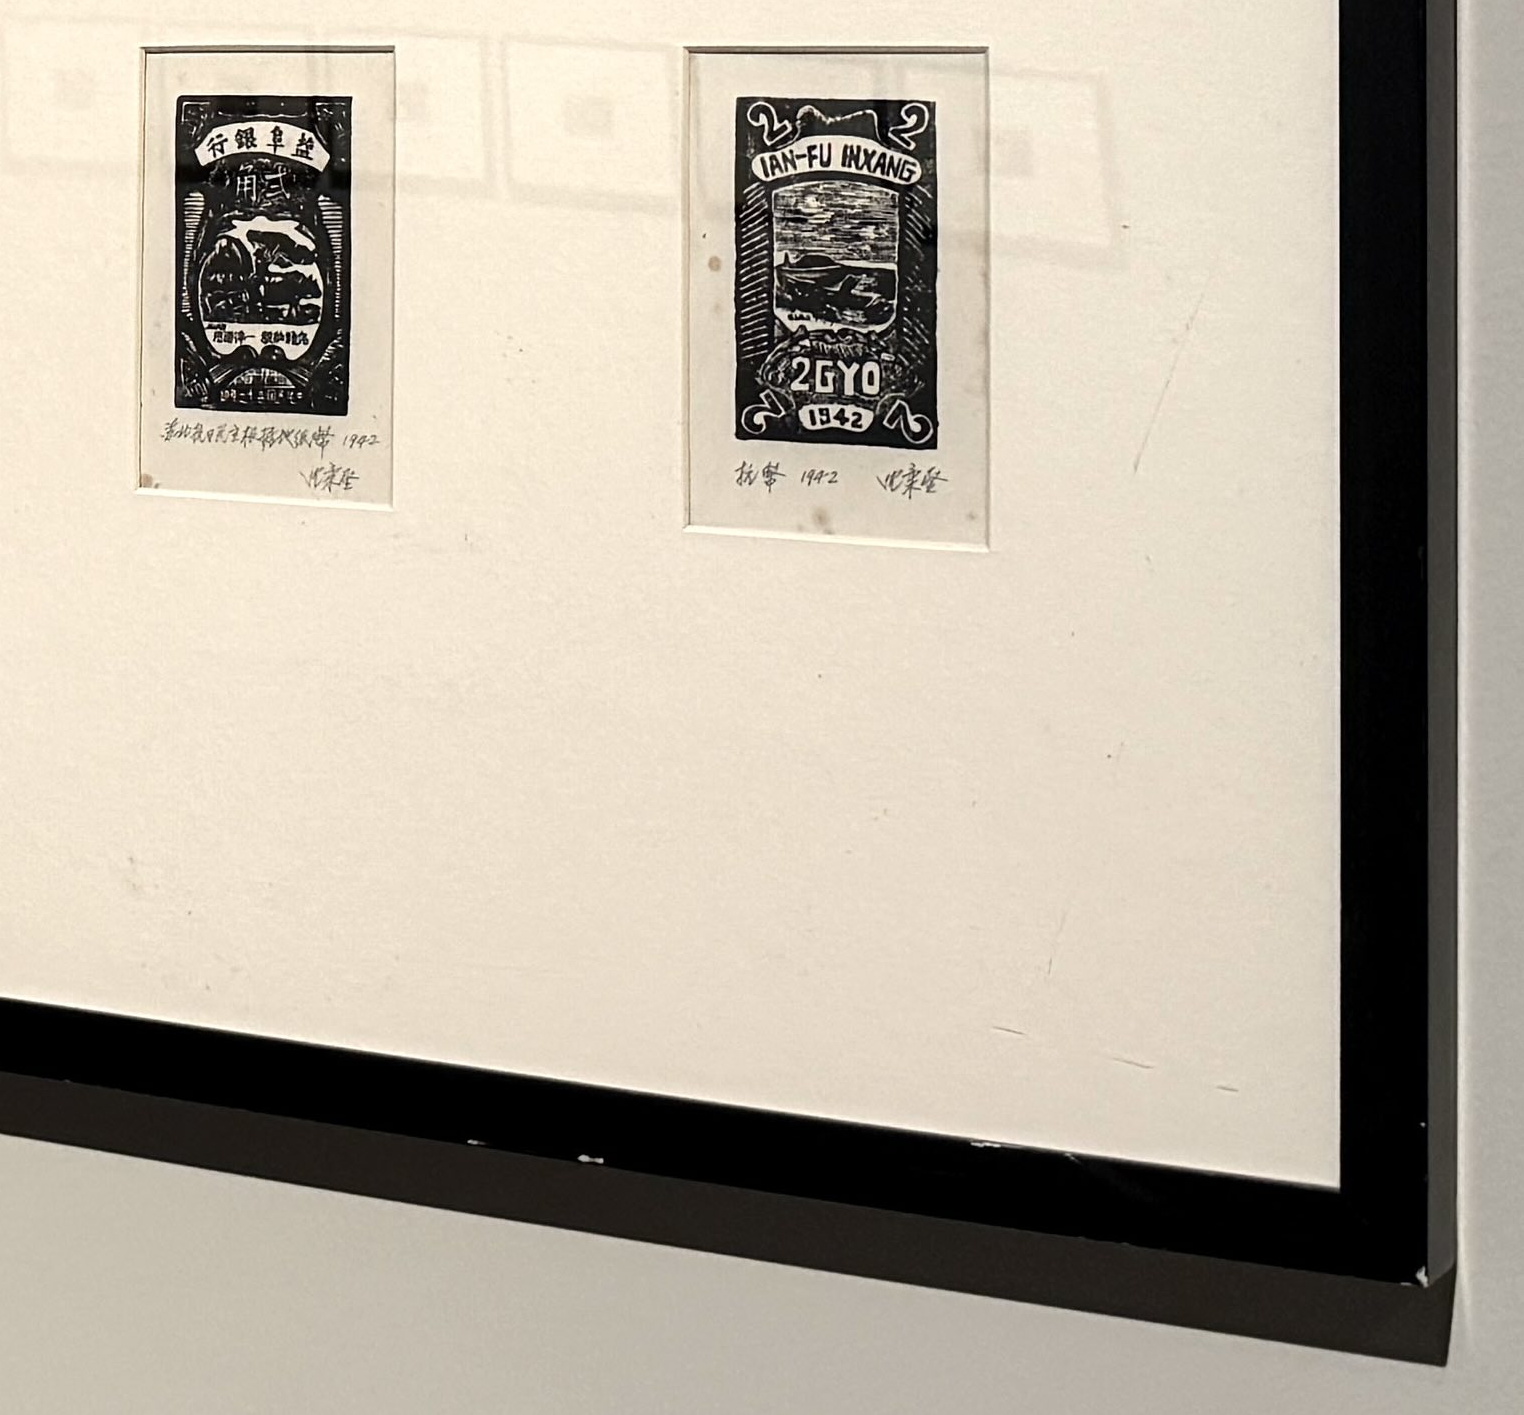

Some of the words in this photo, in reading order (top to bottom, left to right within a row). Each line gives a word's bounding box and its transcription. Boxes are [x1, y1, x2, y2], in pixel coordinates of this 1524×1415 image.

[746, 101, 793, 147] 2
[887, 102, 930, 151] 2
[790, 356, 882, 396] 2GYO
[808, 407, 864, 429] 1942
